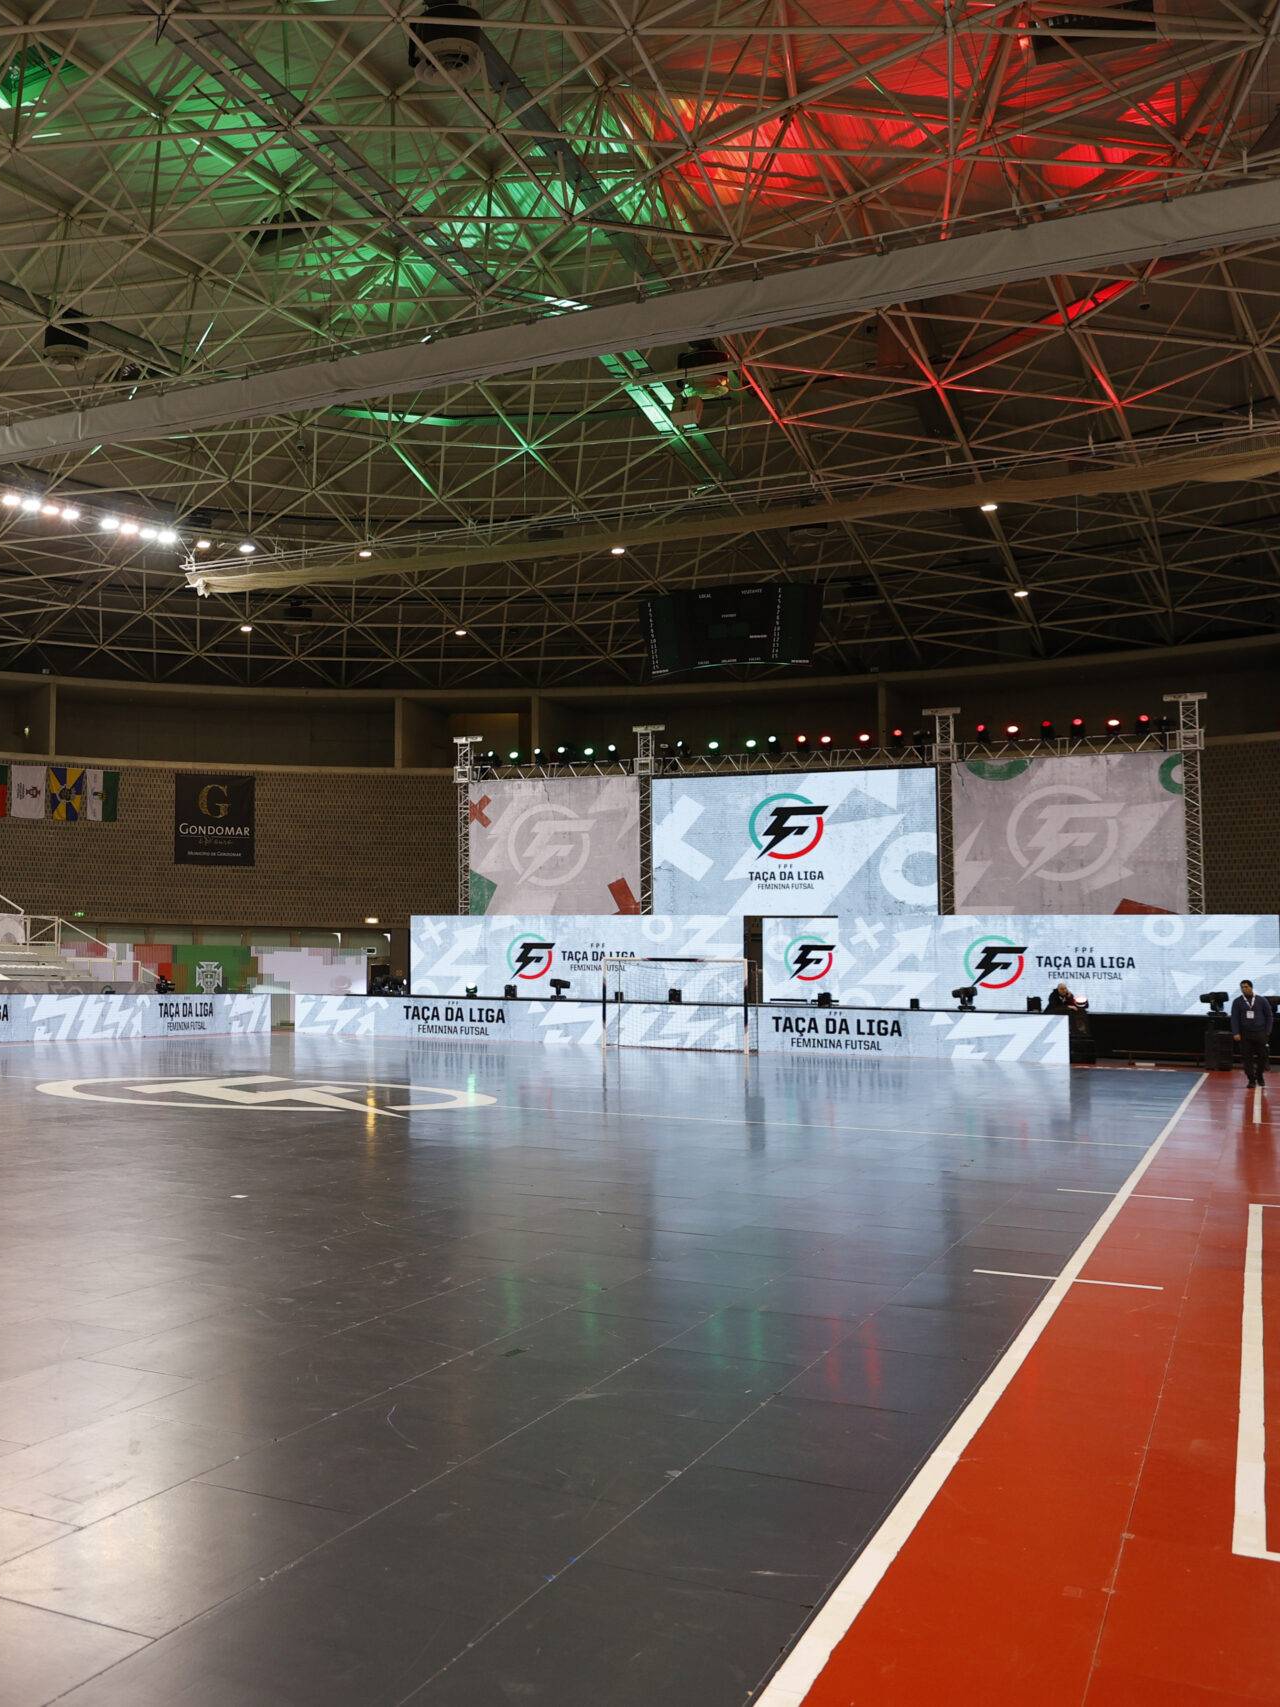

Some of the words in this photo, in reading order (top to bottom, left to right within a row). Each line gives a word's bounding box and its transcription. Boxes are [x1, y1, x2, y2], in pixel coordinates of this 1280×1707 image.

[179, 822, 250, 836] GONDOMAR
[748, 872, 776, 882] TAÇA
[780, 871, 794, 880] DA
[798, 870, 824, 880] LIGA
[561, 951, 588, 963] TAÇA
[592, 951, 606, 961] DA
[1036, 956, 1072, 970] TAÇA
[1077, 956, 1096, 968] DA
[1100, 956, 1136, 969] LIGA
[1048, 972, 1090, 980] FEMININA
[1093, 972, 1122, 980] FUTSAL
[158, 1002, 180, 1021] TAÇA
[182, 1002, 194, 1017] DA
[195, 1002, 214, 1017] LIGA
[403, 1005, 440, 1024] TAÇA
[445, 1007, 464, 1022] DA
[469, 1008, 506, 1024] LIGA
[418, 1024, 458, 1034] FEMININA
[460, 1026, 489, 1036] FUTSAL
[772, 1016, 819, 1037] TAÇA
[826, 1018, 850, 1035] DA
[856, 1019, 902, 1037] LIGA
[790, 1037, 842, 1049] FEMININA
[845, 1040, 882, 1051] FUTSAL
